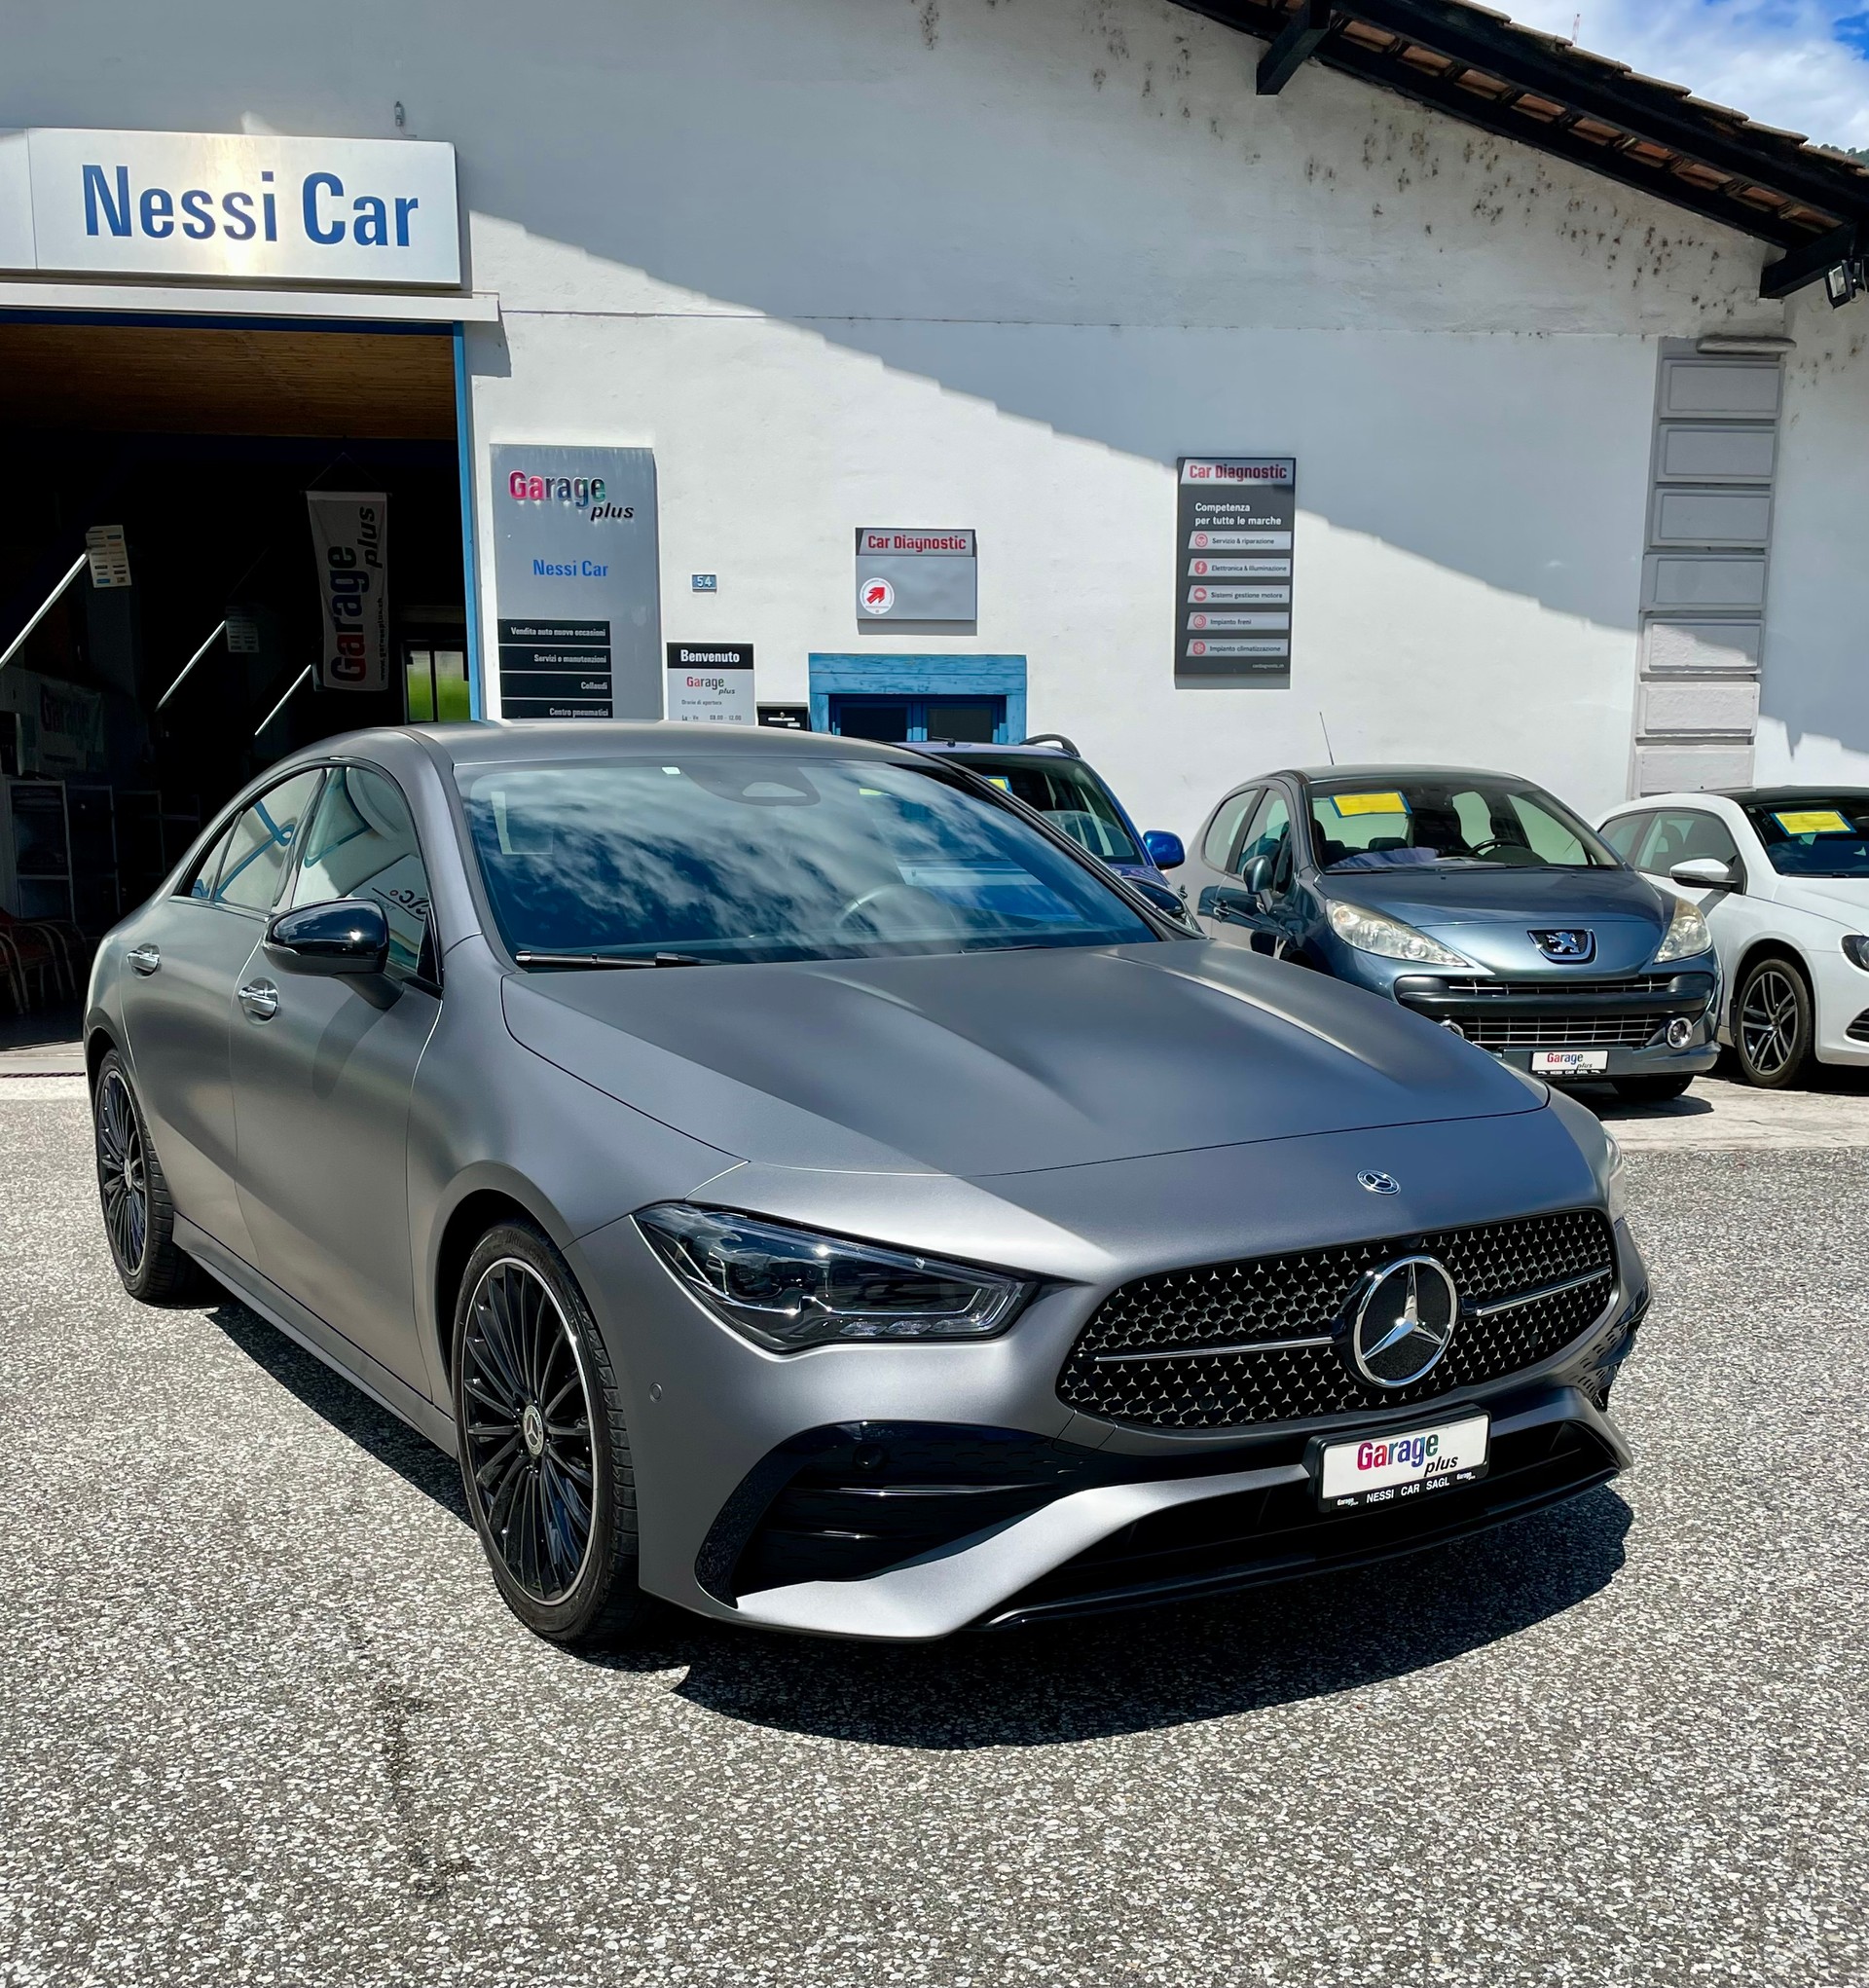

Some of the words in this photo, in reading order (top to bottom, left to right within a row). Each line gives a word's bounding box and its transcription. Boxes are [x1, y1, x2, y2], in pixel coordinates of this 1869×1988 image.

[82, 164, 277, 242] Nessi
[302, 171, 419, 246] Car
[1189, 464, 1212, 478] Car
[1215, 463, 1287, 482] Diagnostic
[509, 470, 605, 509] Garage
[590, 502, 635, 522] plus
[1194, 502, 1250, 513] Competenza
[1194, 517, 1210, 527] per
[1213, 516, 1234, 525] tutte
[1237, 516, 1245, 525] le
[1248, 516, 1282, 525] marche
[357, 506, 383, 569] plus
[867, 535, 891, 548] Car
[894, 534, 967, 553] Diagnostic
[532, 560, 576, 576] Nessi
[582, 561, 608, 576] Car
[697, 575, 713, 587] 54
[327, 546, 370, 681] Garage
[510, 626, 536, 636] Vendita
[574, 628, 605, 637] occasioni
[534, 653, 556, 662] Servizi
[680, 649, 740, 663] Benvenuto
[686, 677, 724, 690] Garage
[572, 709, 608, 718] pneumatici
[1547, 1052, 1584, 1065] Garage
[1357, 1433, 1439, 1471] Garage
[1423, 1455, 1458, 1478] plus
[1367, 1490, 1394, 1503] NESSI
[1401, 1484, 1420, 1496] CAR
[1426, 1476, 1450, 1491] SAGL
